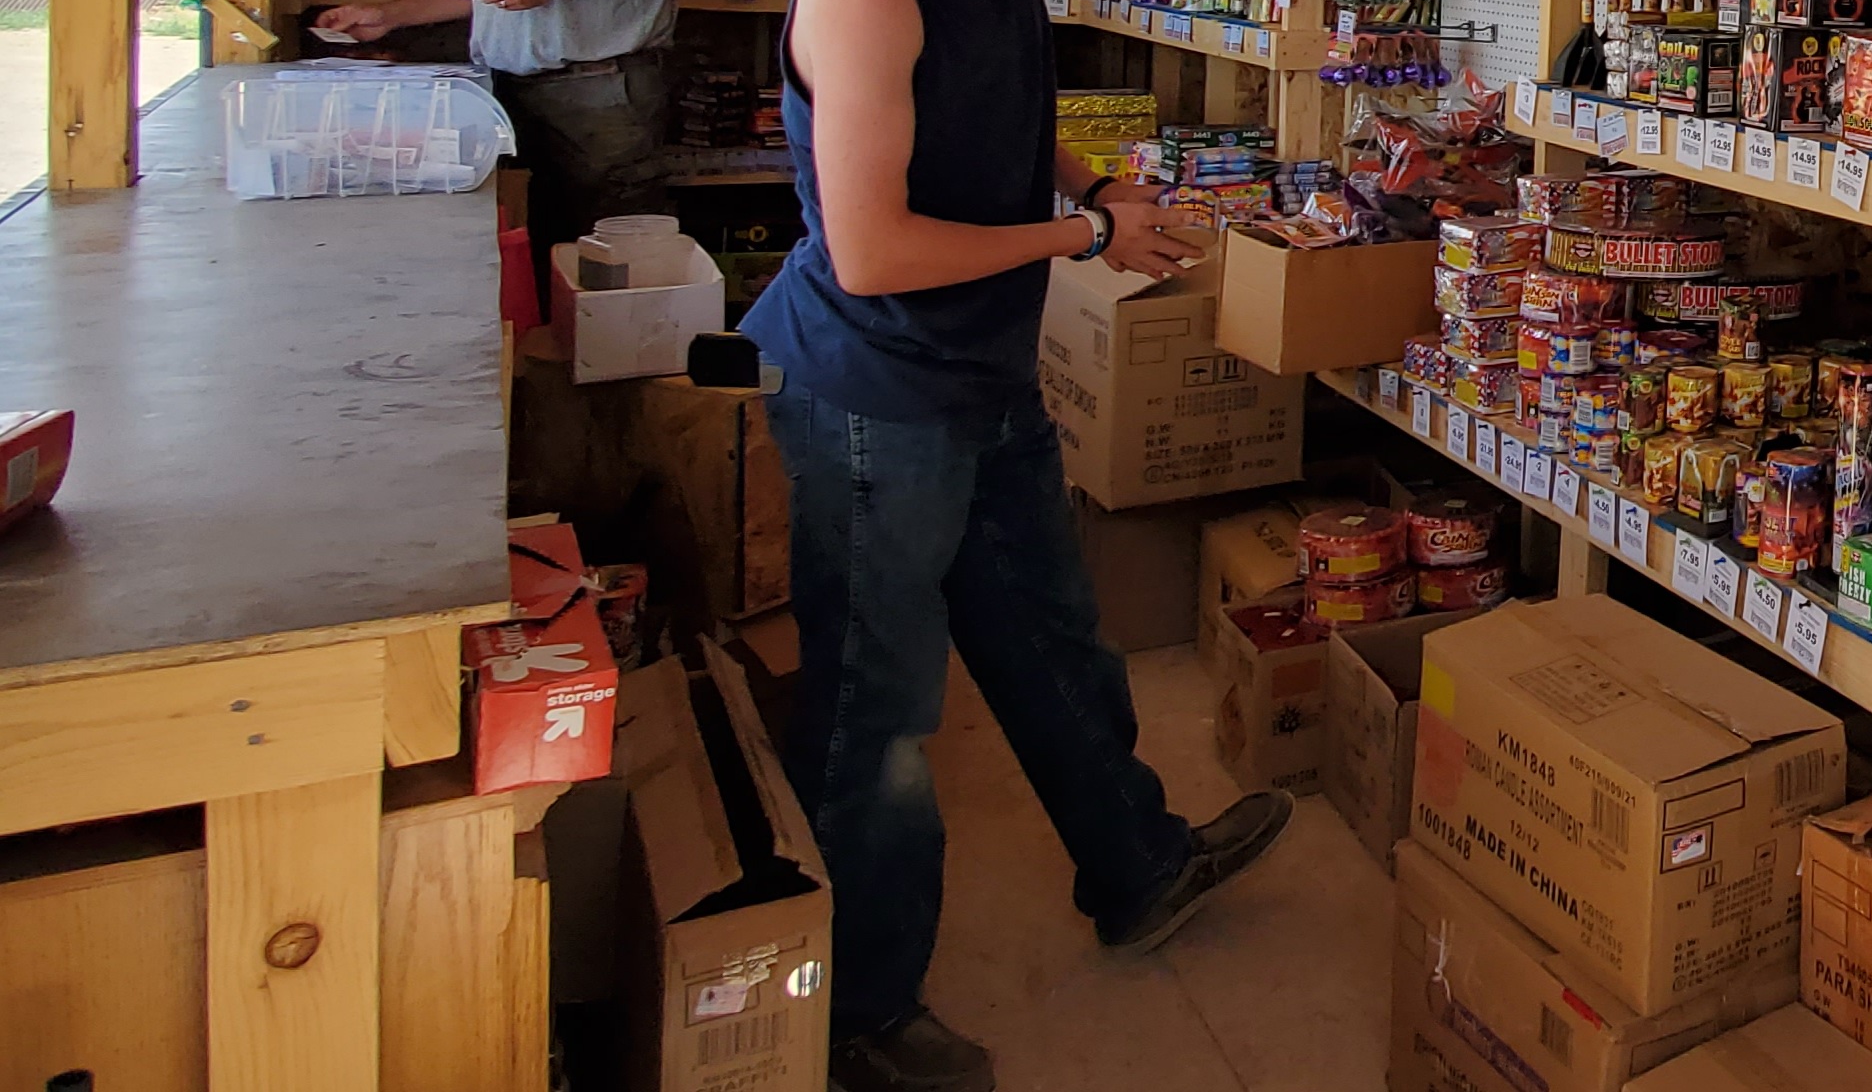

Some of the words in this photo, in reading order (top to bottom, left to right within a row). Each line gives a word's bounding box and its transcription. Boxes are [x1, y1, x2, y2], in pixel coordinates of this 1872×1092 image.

[1603, 239, 1677, 267] BULLET
[1679, 239, 1724, 267] STOR
[546, 687, 616, 707] storage
[1497, 729, 1556, 788] KM1848
[1417, 802, 1471, 861] 1001848
[1465, 814, 1507, 862] MADE
[1510, 849, 1526, 877] IN
[1528, 865, 1580, 922] CHINA
[1814, 958, 1853, 998] PARA
